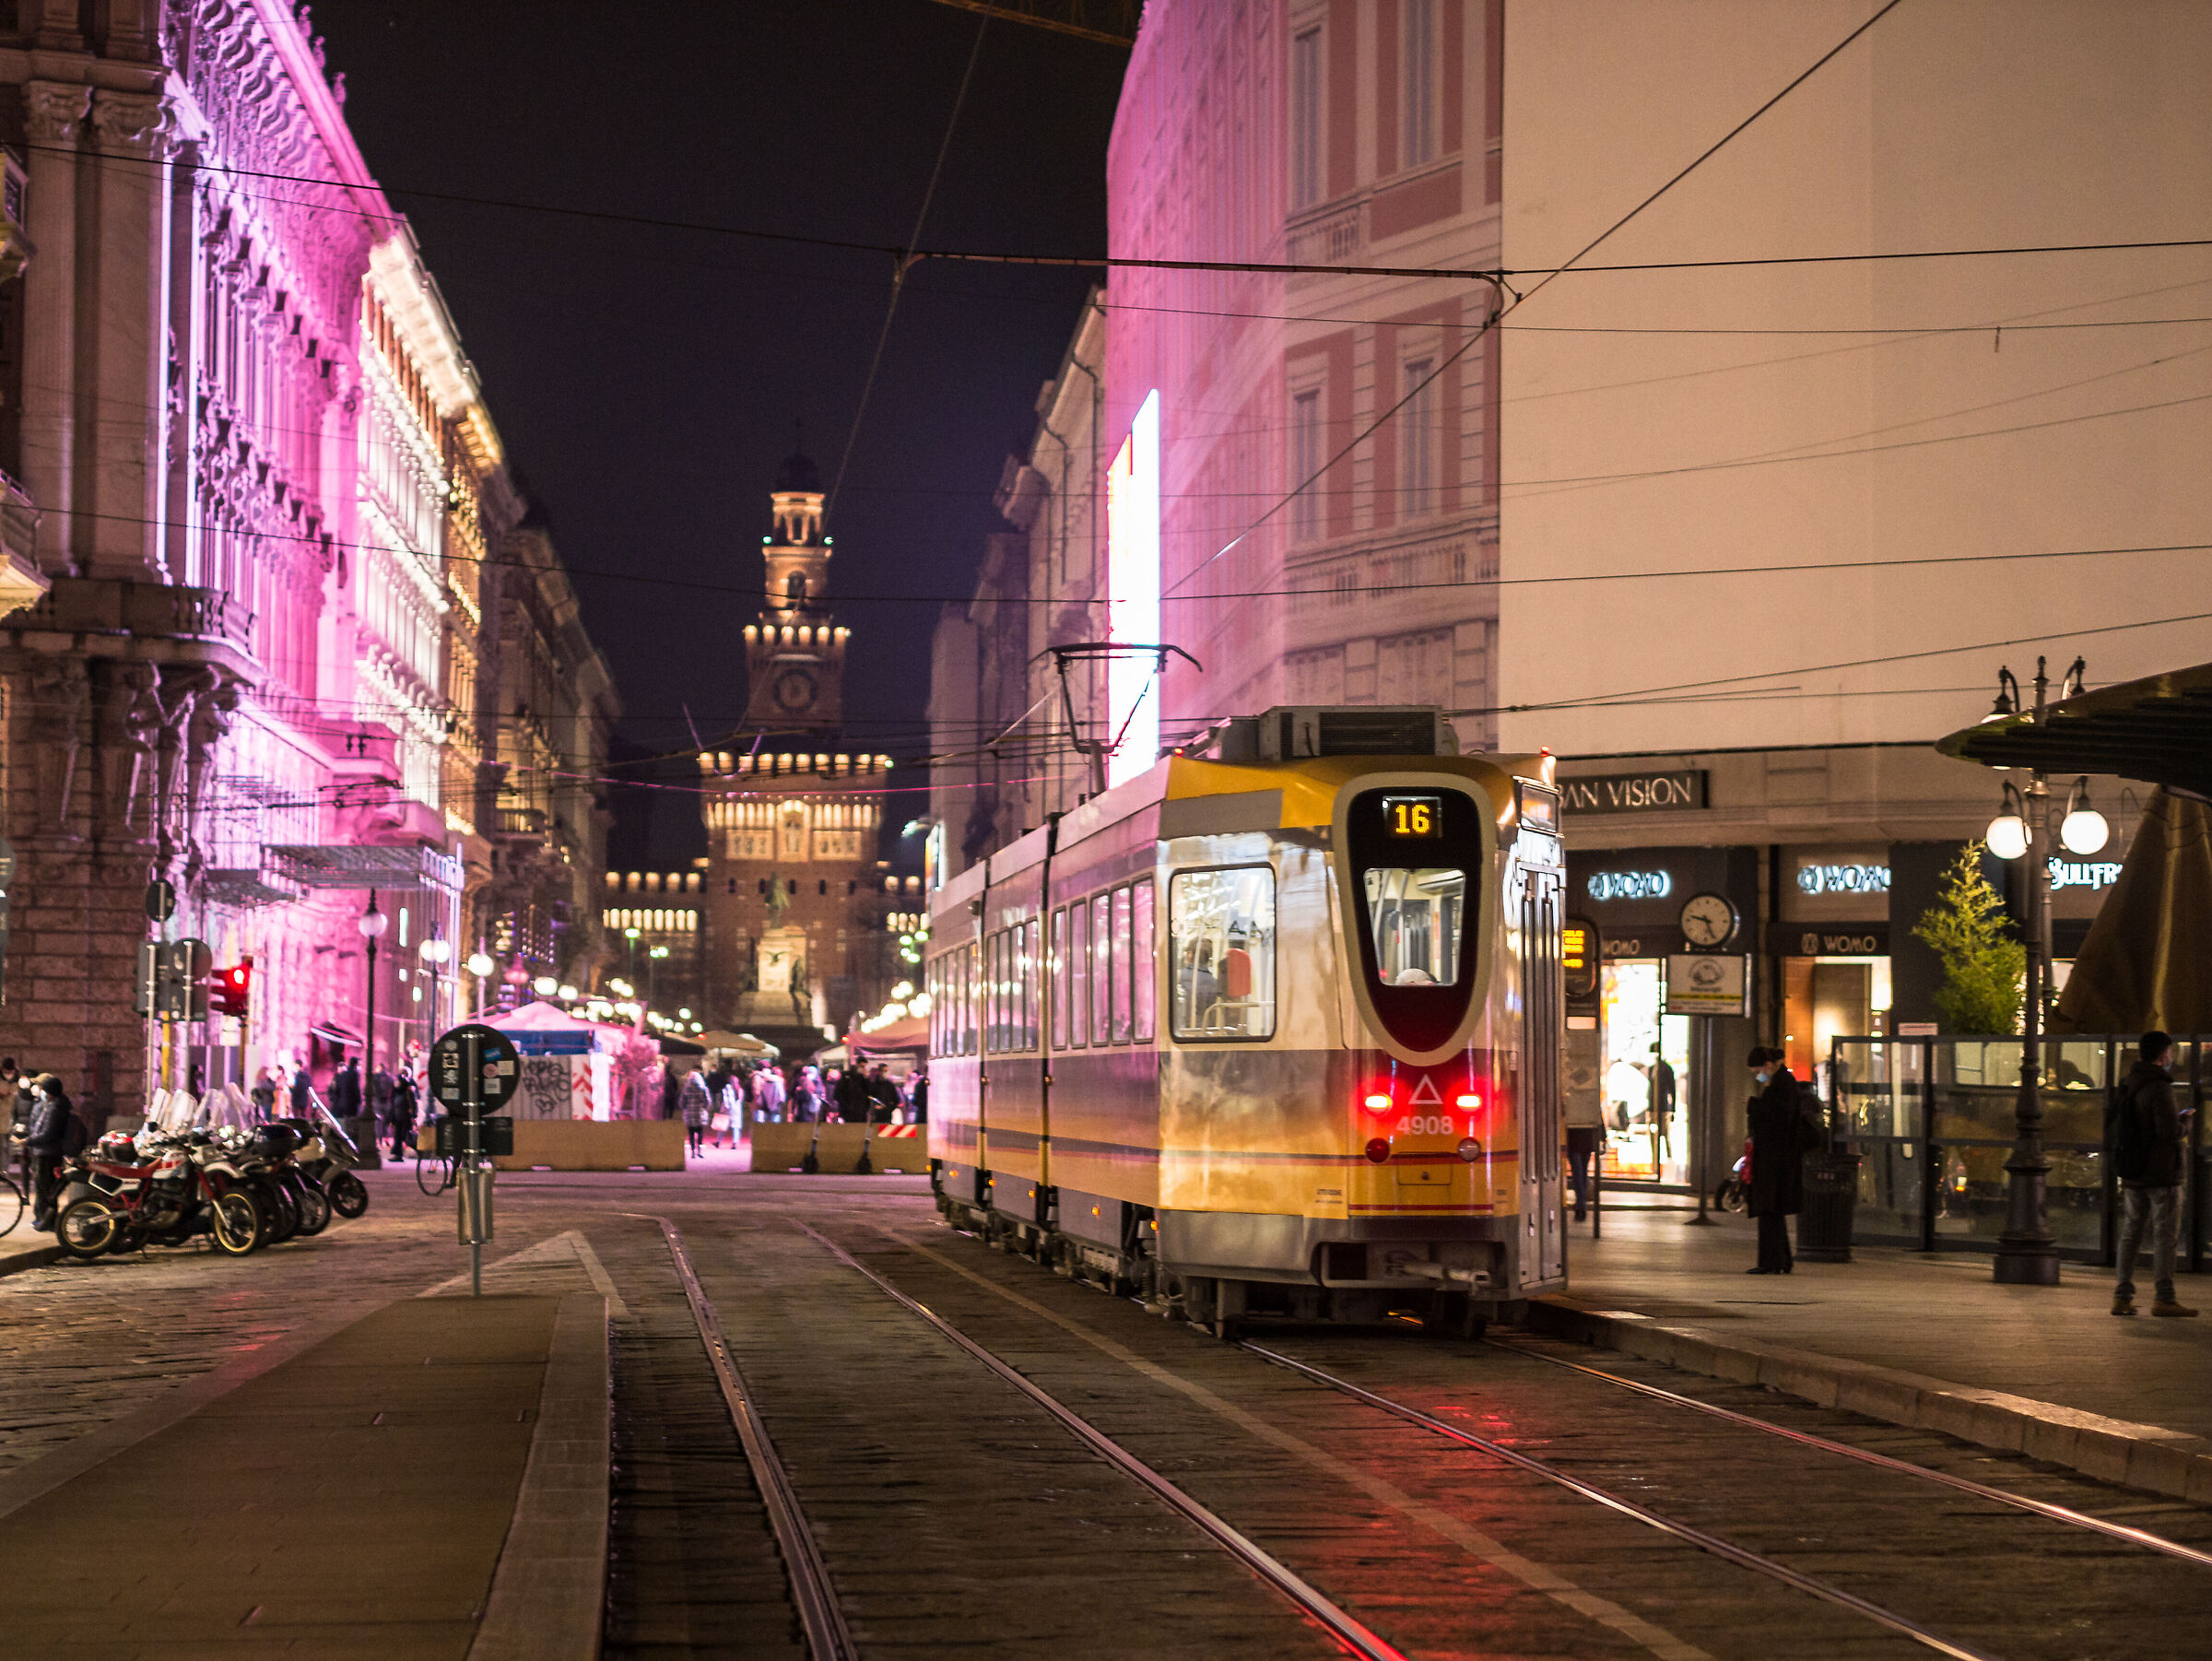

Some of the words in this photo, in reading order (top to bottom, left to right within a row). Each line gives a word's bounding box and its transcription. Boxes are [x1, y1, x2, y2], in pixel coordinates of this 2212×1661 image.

[1555, 782, 1599, 808] BAN
[1606, 777, 1691, 807] VISION
[1395, 804, 1430, 834] 16
[2048, 856, 2124, 890] BULLFR
[1823, 935, 1877, 953] WOMO
[1396, 1115, 1454, 1136] 4908
